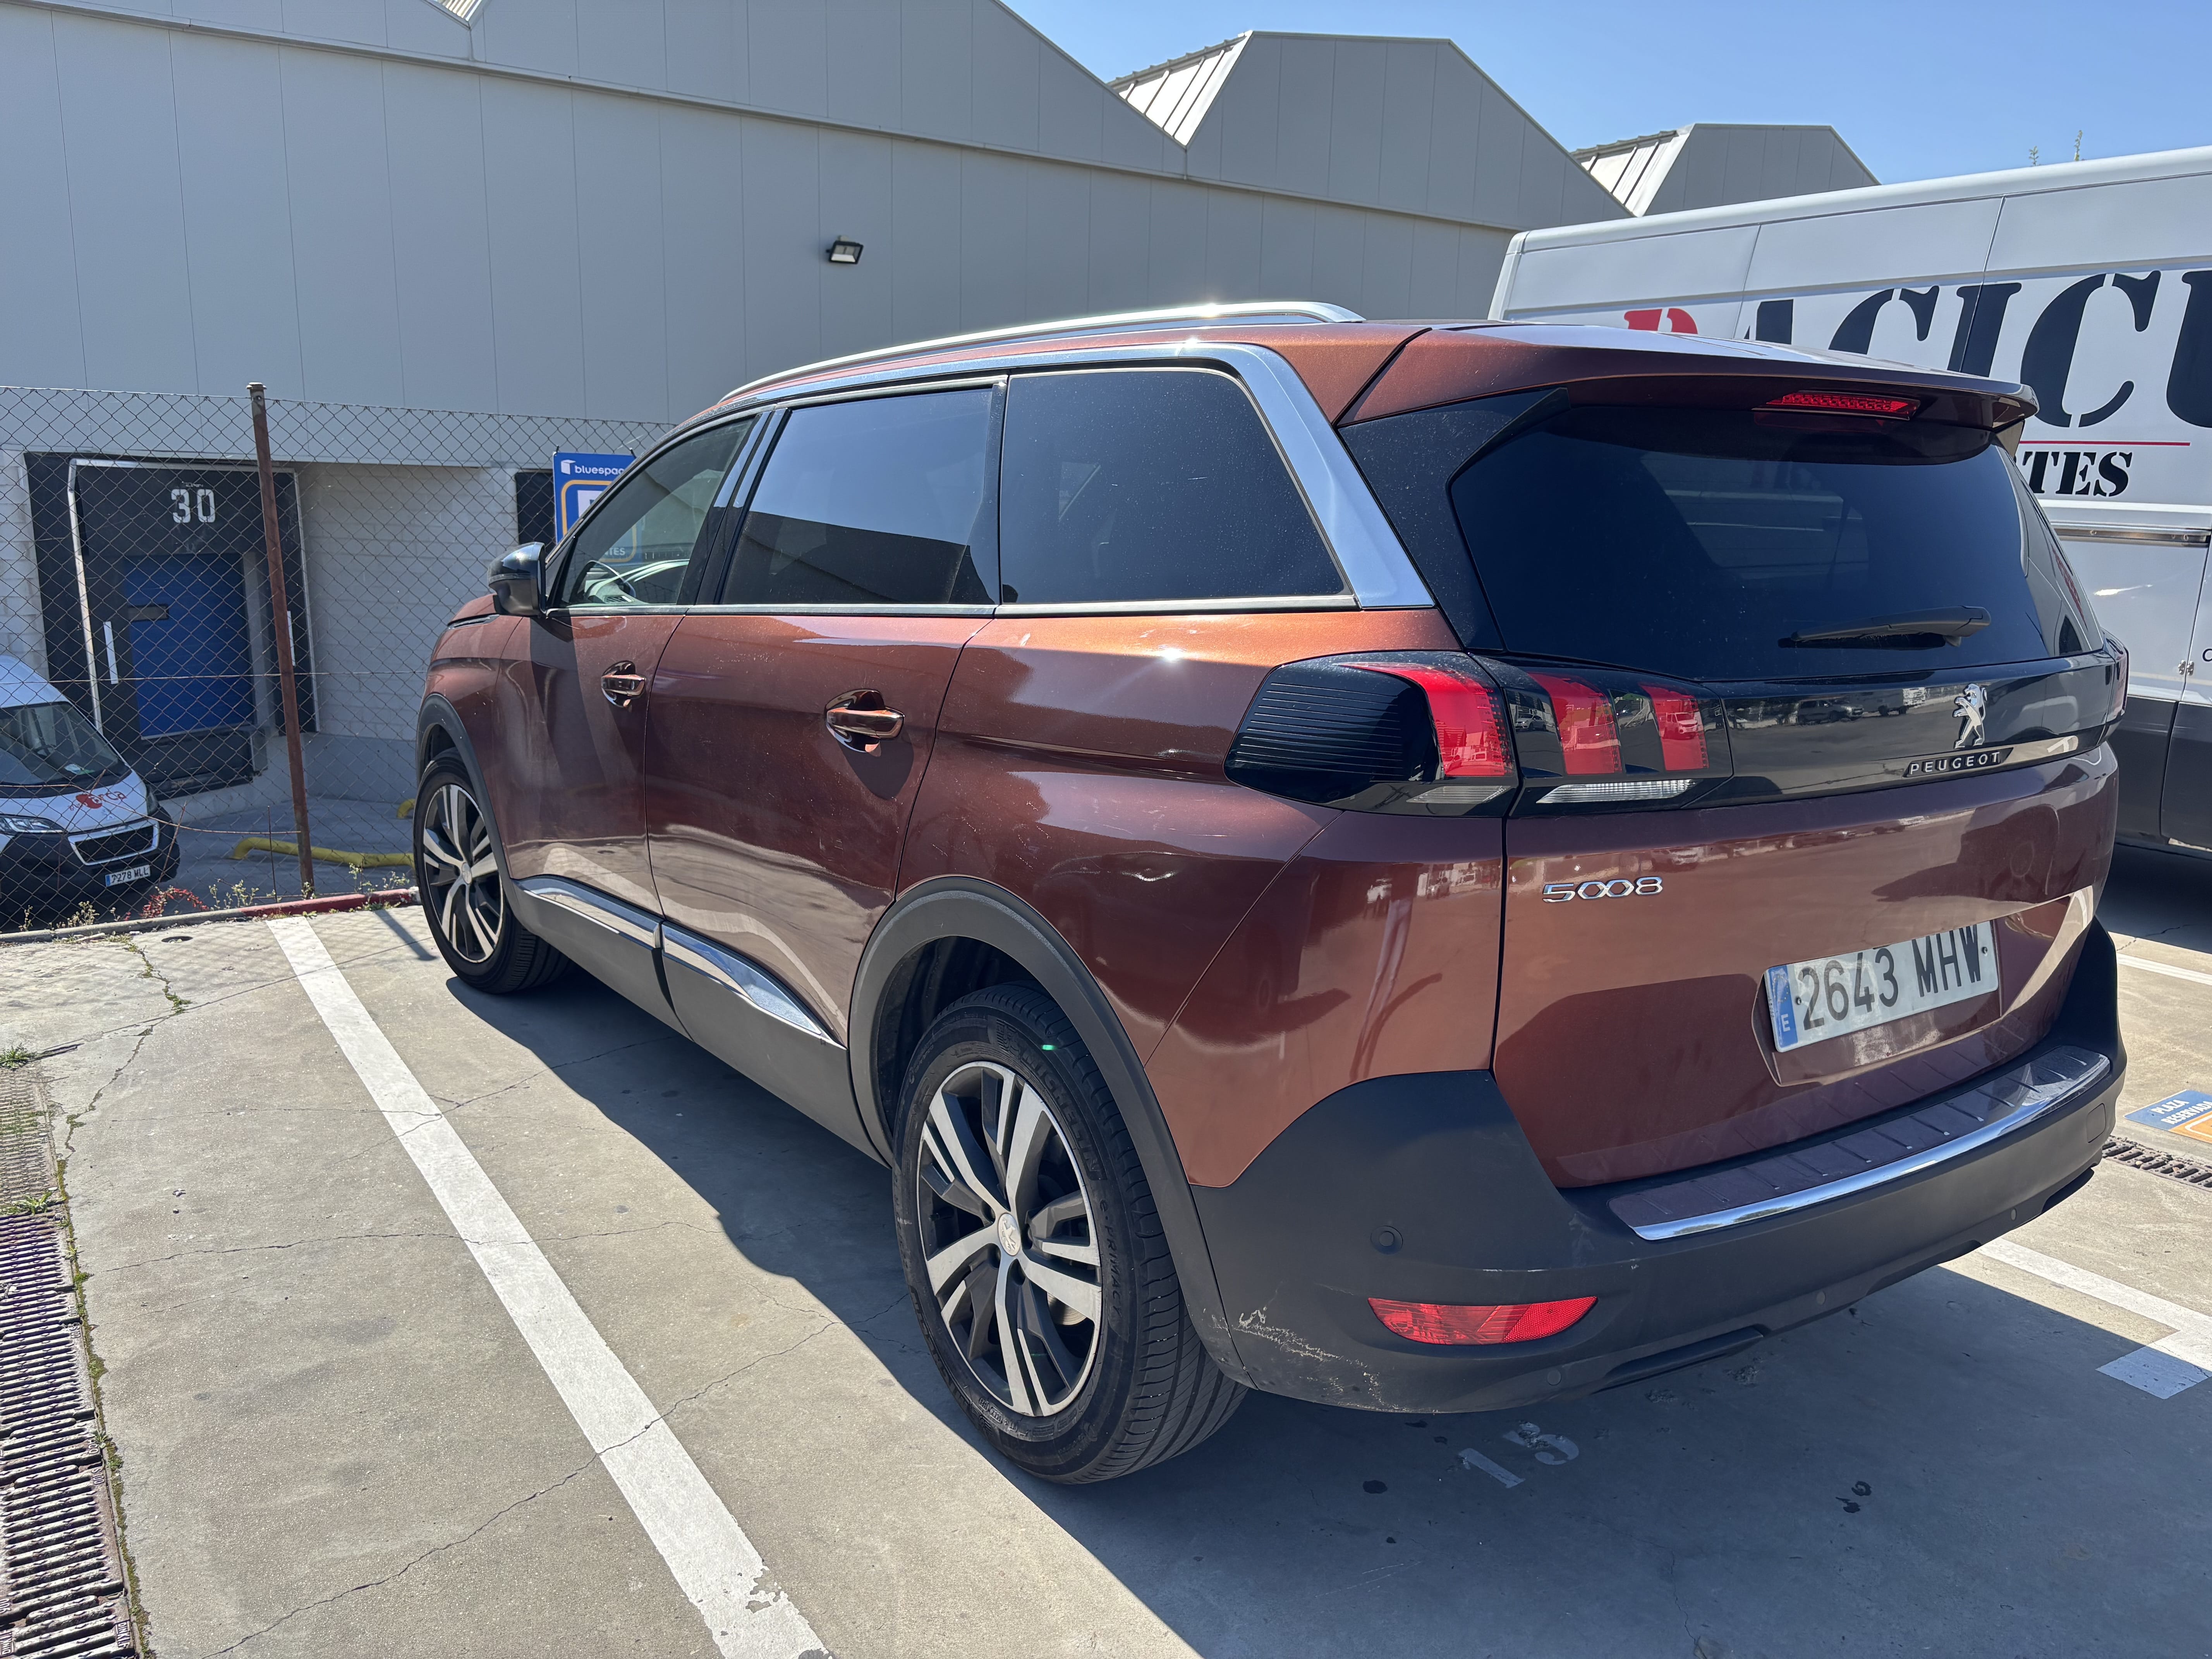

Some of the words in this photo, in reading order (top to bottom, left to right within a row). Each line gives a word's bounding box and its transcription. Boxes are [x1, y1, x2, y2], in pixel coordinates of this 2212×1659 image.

[2014, 452, 2132, 497] TES
[171, 489, 216, 523] 30
[1910, 751, 2000, 775] PEUGEOT
[1542, 876, 1663, 903] 5008
[1798, 948, 1899, 1030] 2643
[1911, 923, 1981, 998] MHW
[1781, 1013, 1791, 1032] E
[1022, 1049, 1101, 1176] MICHELIN
[2150, 1099, 2190, 1115] PLAZA
[93, 1474, 105, 1484] 100
